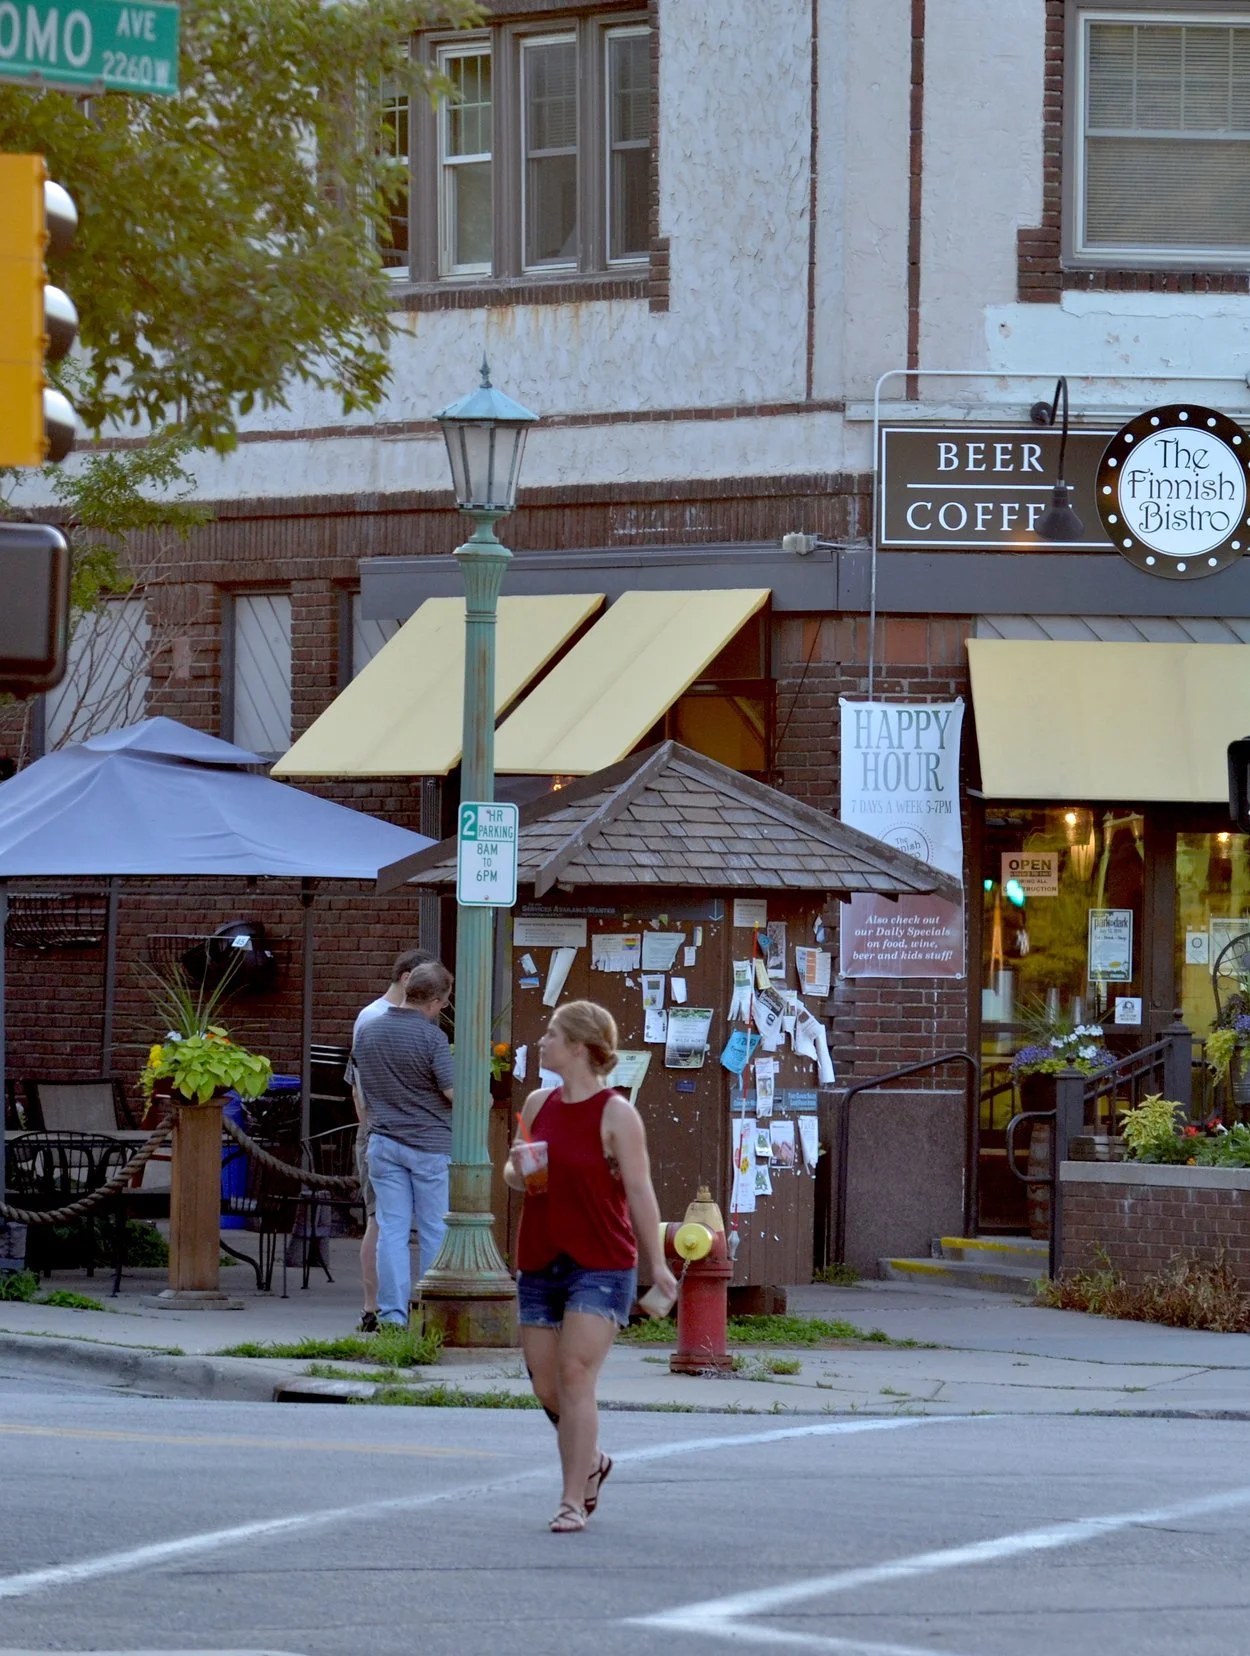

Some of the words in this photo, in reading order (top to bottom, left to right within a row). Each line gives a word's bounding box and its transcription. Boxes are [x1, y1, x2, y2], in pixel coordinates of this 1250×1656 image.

[116, 8, 157, 41] AVE
[937, 443, 1044, 472] BEER
[1154, 438, 1210, 472] The
[1127, 468, 1235, 500] Finnish
[906, 501, 1073, 531] COFFE
[1138, 501, 1230, 533] Bistro
[854, 709, 952, 750] HAPPY
[861, 751, 944, 792] HOUR
[860, 799, 884, 814] DAYS
[886, 800, 893, 814] A
[896, 800, 923, 814] WEEK
[926, 800, 952, 814] 5-7PM
[463, 810, 476, 836] 2
[488, 810, 503, 822] HR
[479, 825, 513, 839] PARKING
[477, 843, 498, 855] 8AM
[483, 858, 492, 868] TO
[1009, 859, 1051, 870] OPEN
[476, 869, 497, 882] 6PM
[865, 915, 888, 925] Also
[890, 915, 920, 924] check
[922, 916, 940, 924] out
[876, 927, 905, 938] Daily
[907, 927, 951, 938] Specials
[882, 939, 908, 949] food,
[911, 939, 938, 949] wine,
[853, 951, 875, 960] beer
[877, 951, 898, 960] and
[901, 951, 923, 960] kids
[925, 950, 953, 961] stuff!
